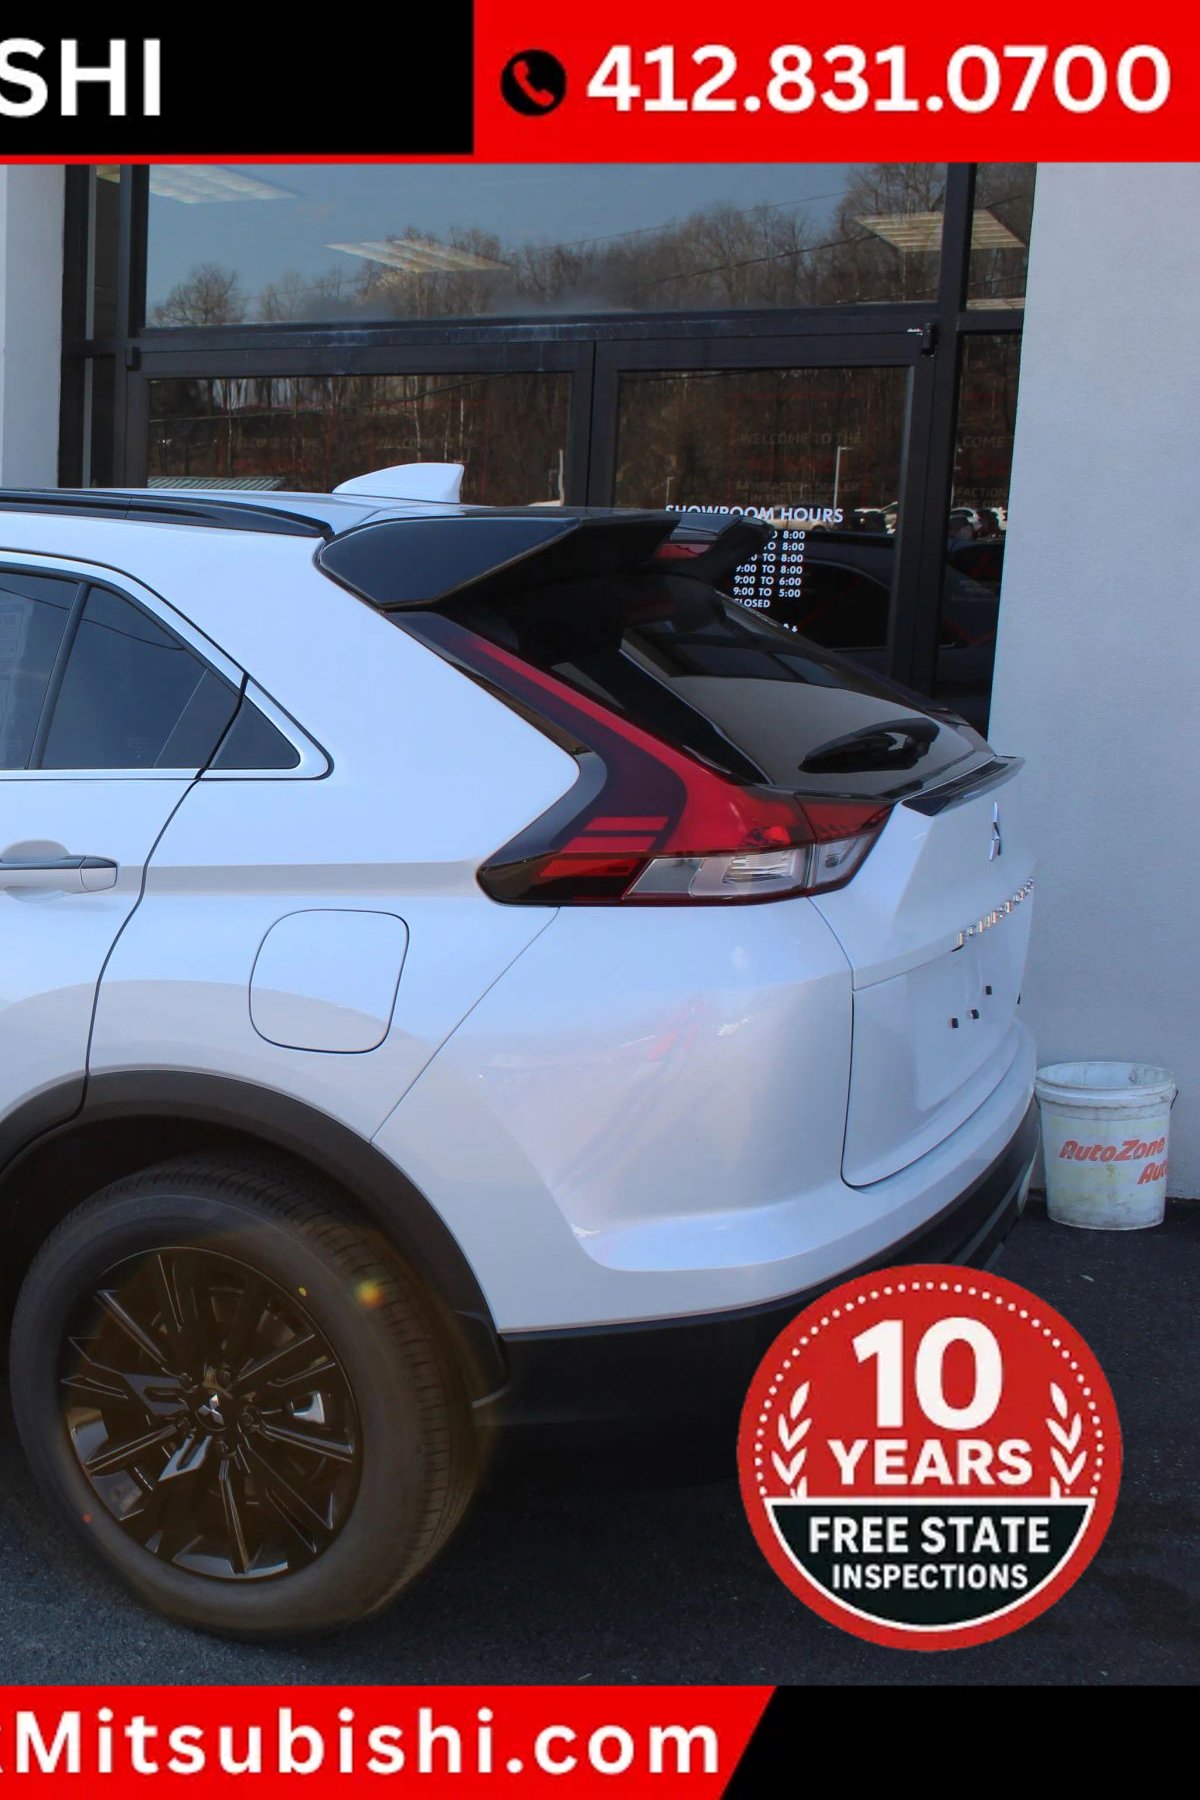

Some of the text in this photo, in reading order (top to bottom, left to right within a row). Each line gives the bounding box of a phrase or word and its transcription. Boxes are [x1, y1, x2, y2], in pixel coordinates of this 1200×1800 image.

[780, 507, 844, 523] HOURS
[782, 530, 806, 540] 8:00
[782, 542, 805, 551] 8:00
[762, 553, 777, 562] TO
[781, 554, 804, 563] 8:00
[762, 565, 776, 574] TO
[780, 565, 803, 575] 8:00
[734, 575, 802, 586] 9:00 TO 6:00
[733, 587, 801, 598] 9:00 TO 5:00
[1059, 1136, 1166, 1162] AutoZone
